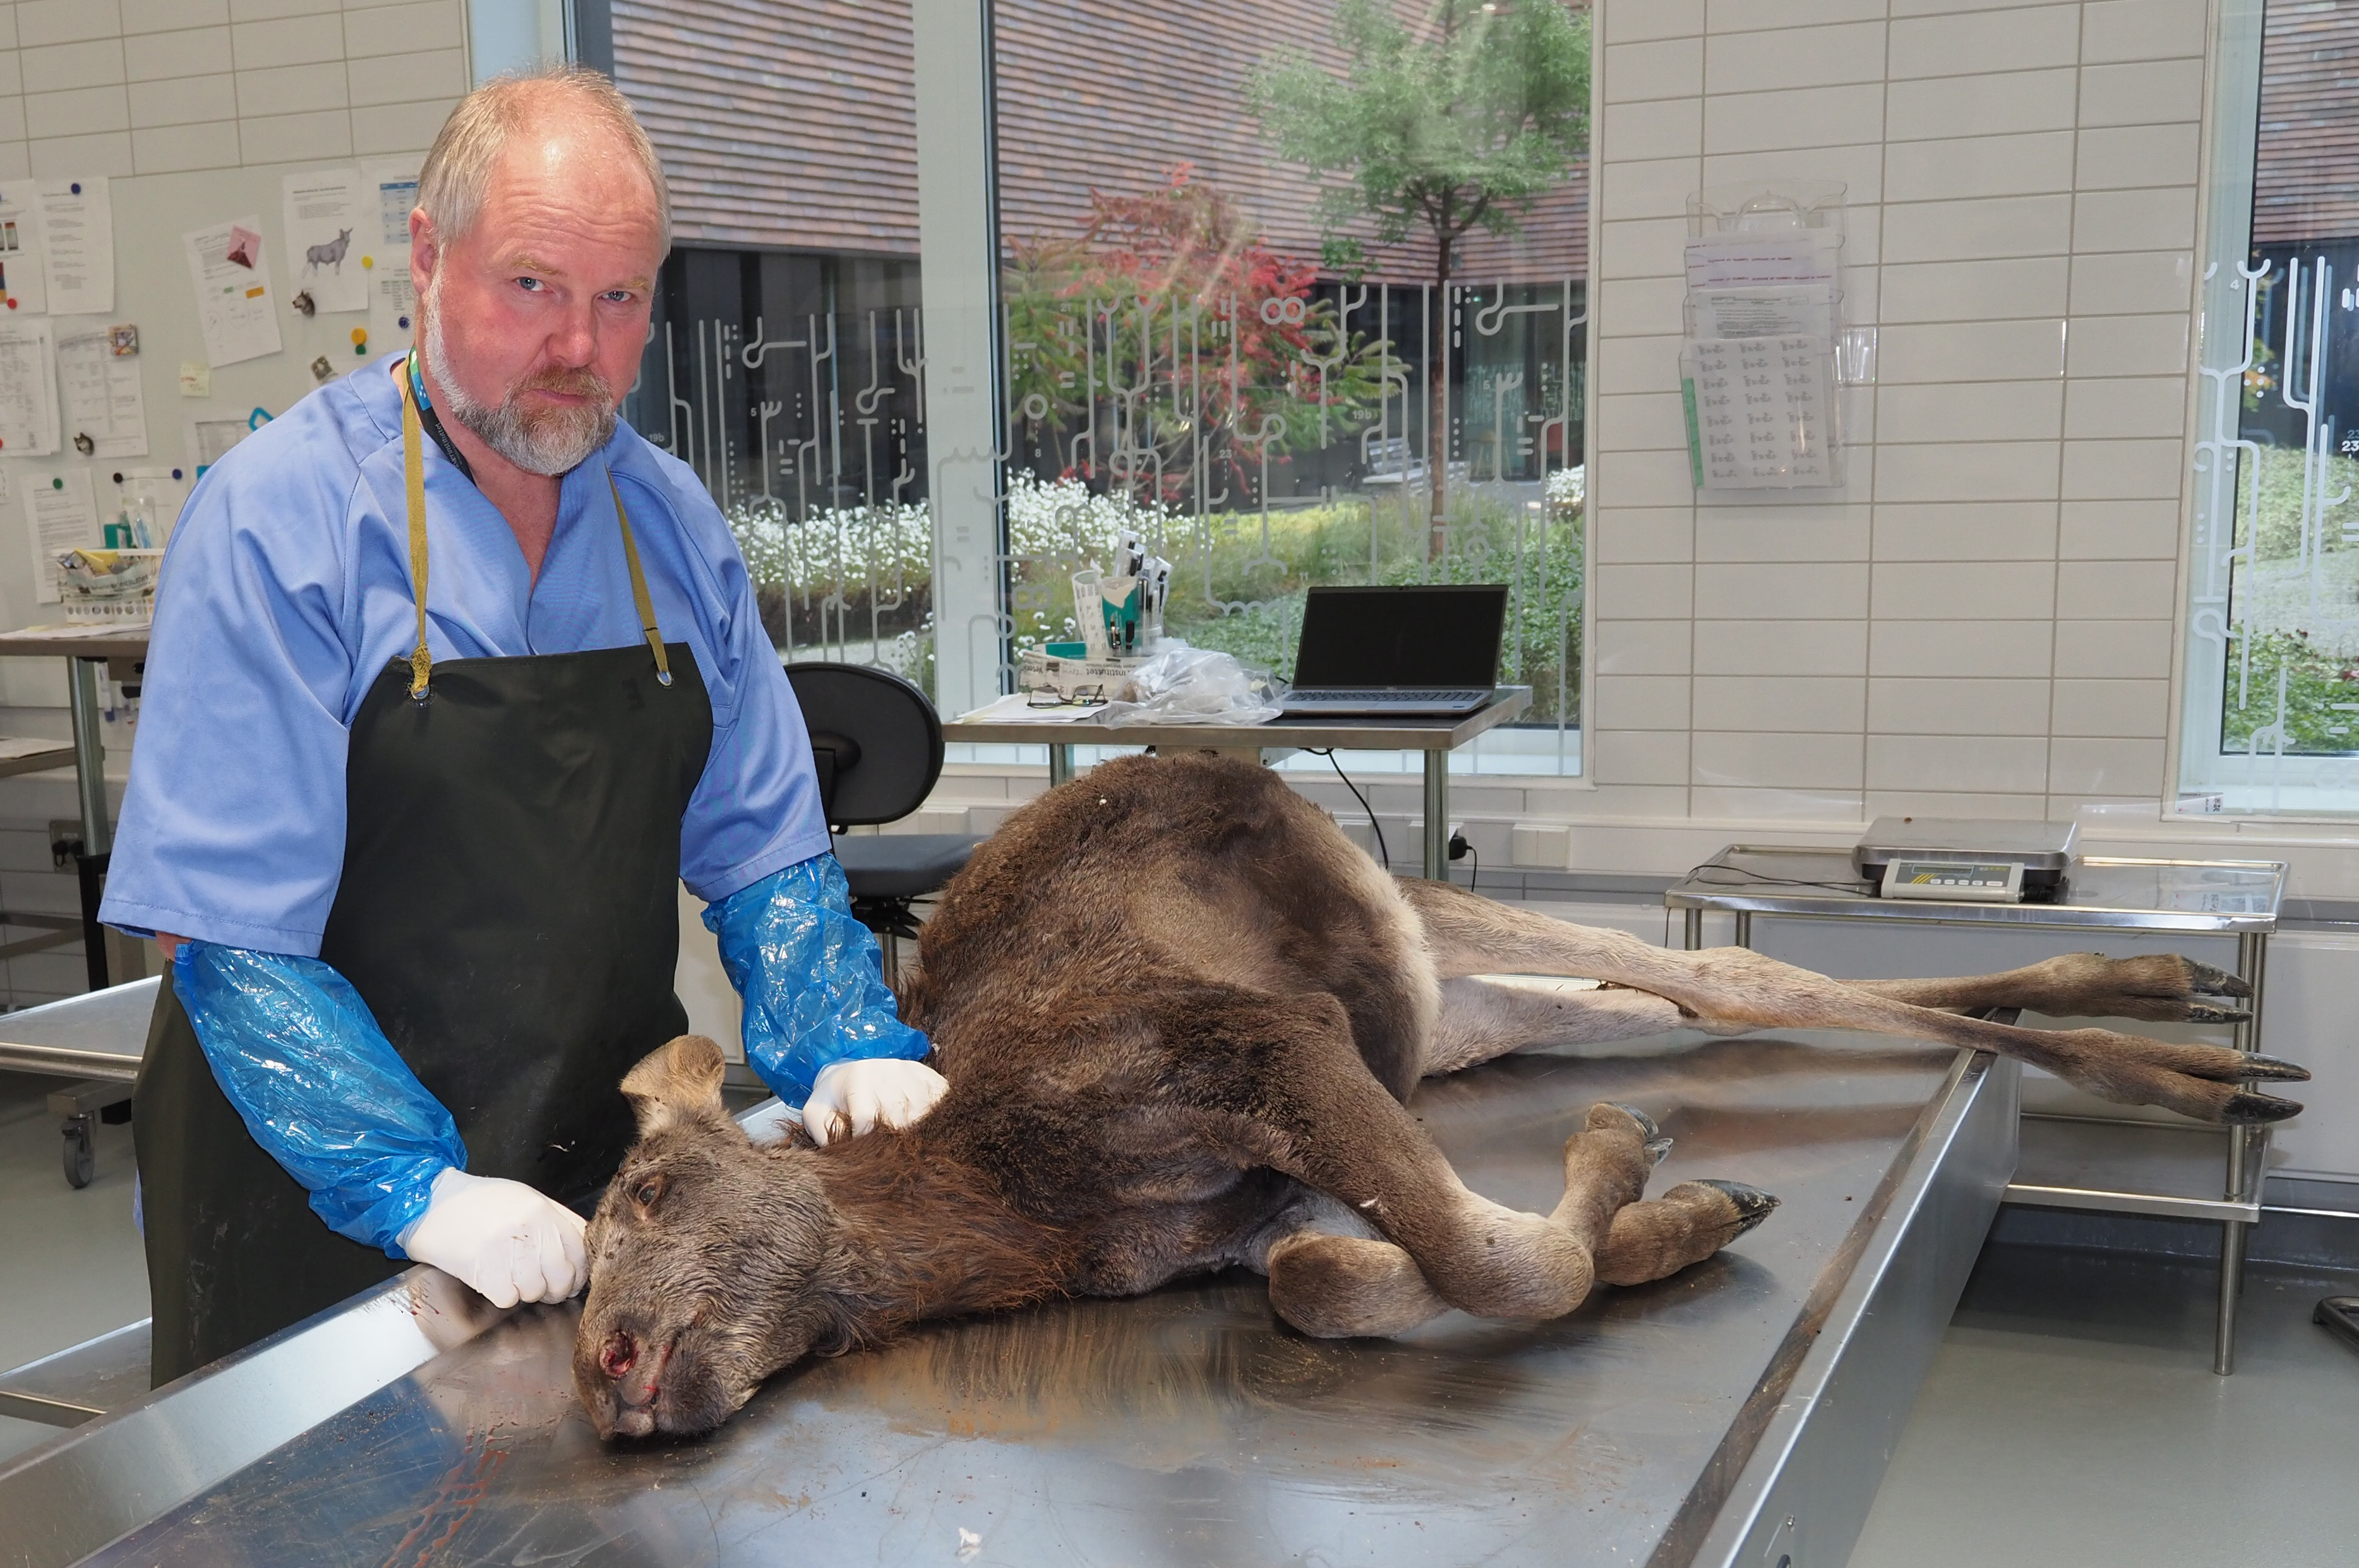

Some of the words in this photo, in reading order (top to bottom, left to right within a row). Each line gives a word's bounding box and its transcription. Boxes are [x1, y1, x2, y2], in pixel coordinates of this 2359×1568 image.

[750, 407, 757, 417] 5
[1352, 409, 1372, 420] 19b
[649, 433, 665, 442] 19b
[1034, 448, 1041, 458] 8
[1220, 449, 1232, 458] 23
